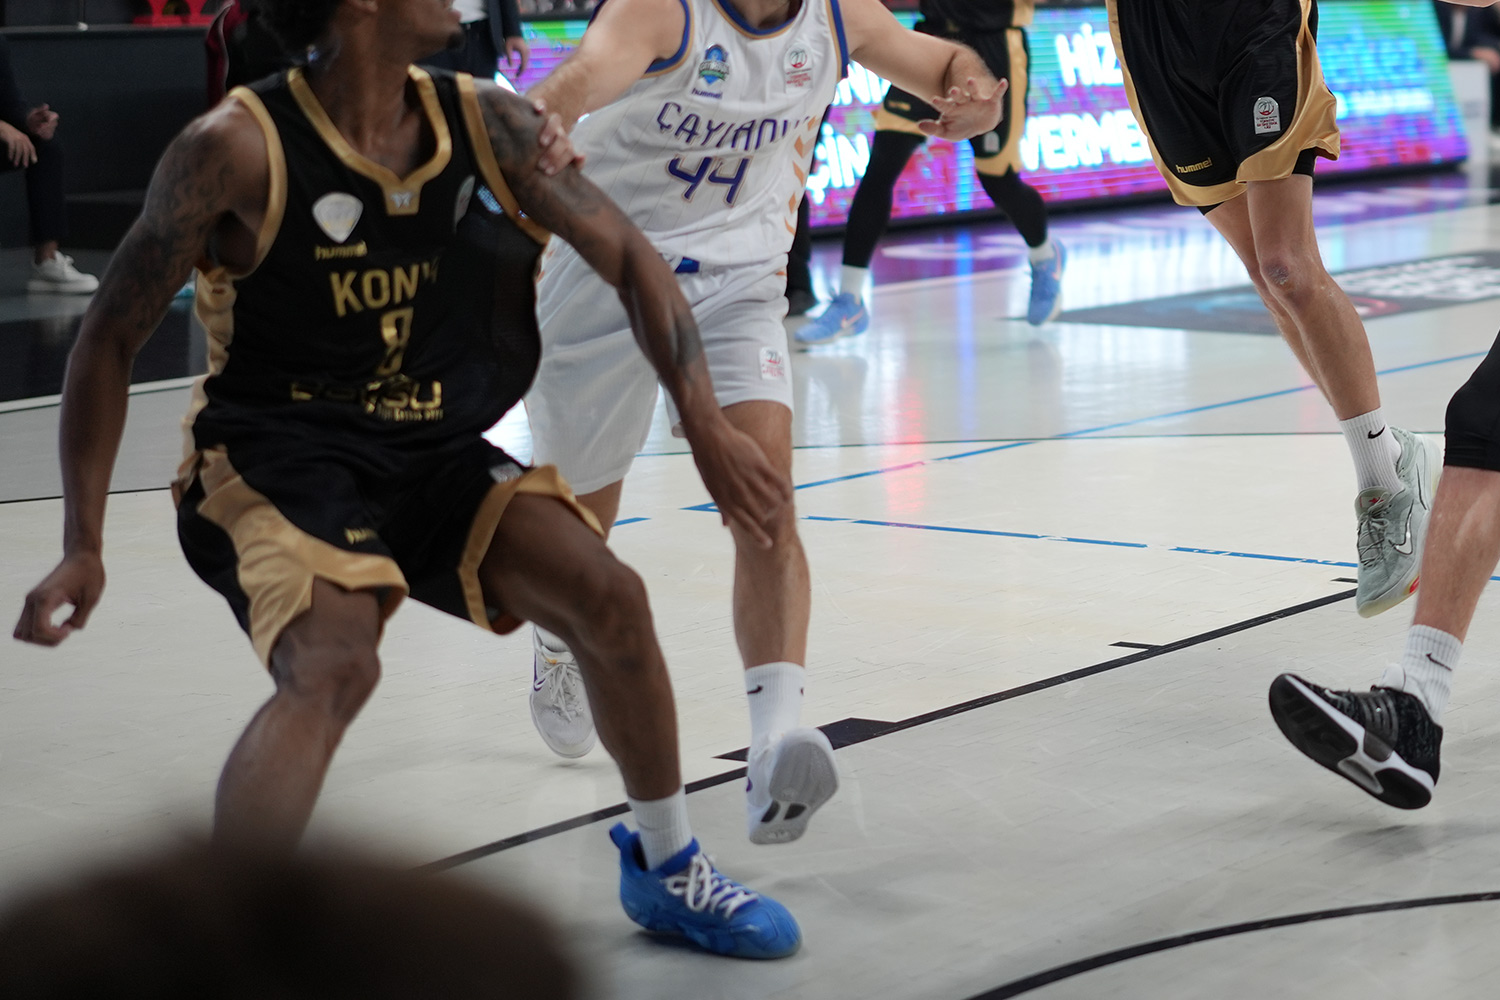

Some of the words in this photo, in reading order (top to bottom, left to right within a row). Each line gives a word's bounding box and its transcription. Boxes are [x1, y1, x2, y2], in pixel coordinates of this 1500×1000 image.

[691, 88, 724, 100] hummel
[1177, 157, 1213, 174] hummel
[667, 155, 750, 205] 44
